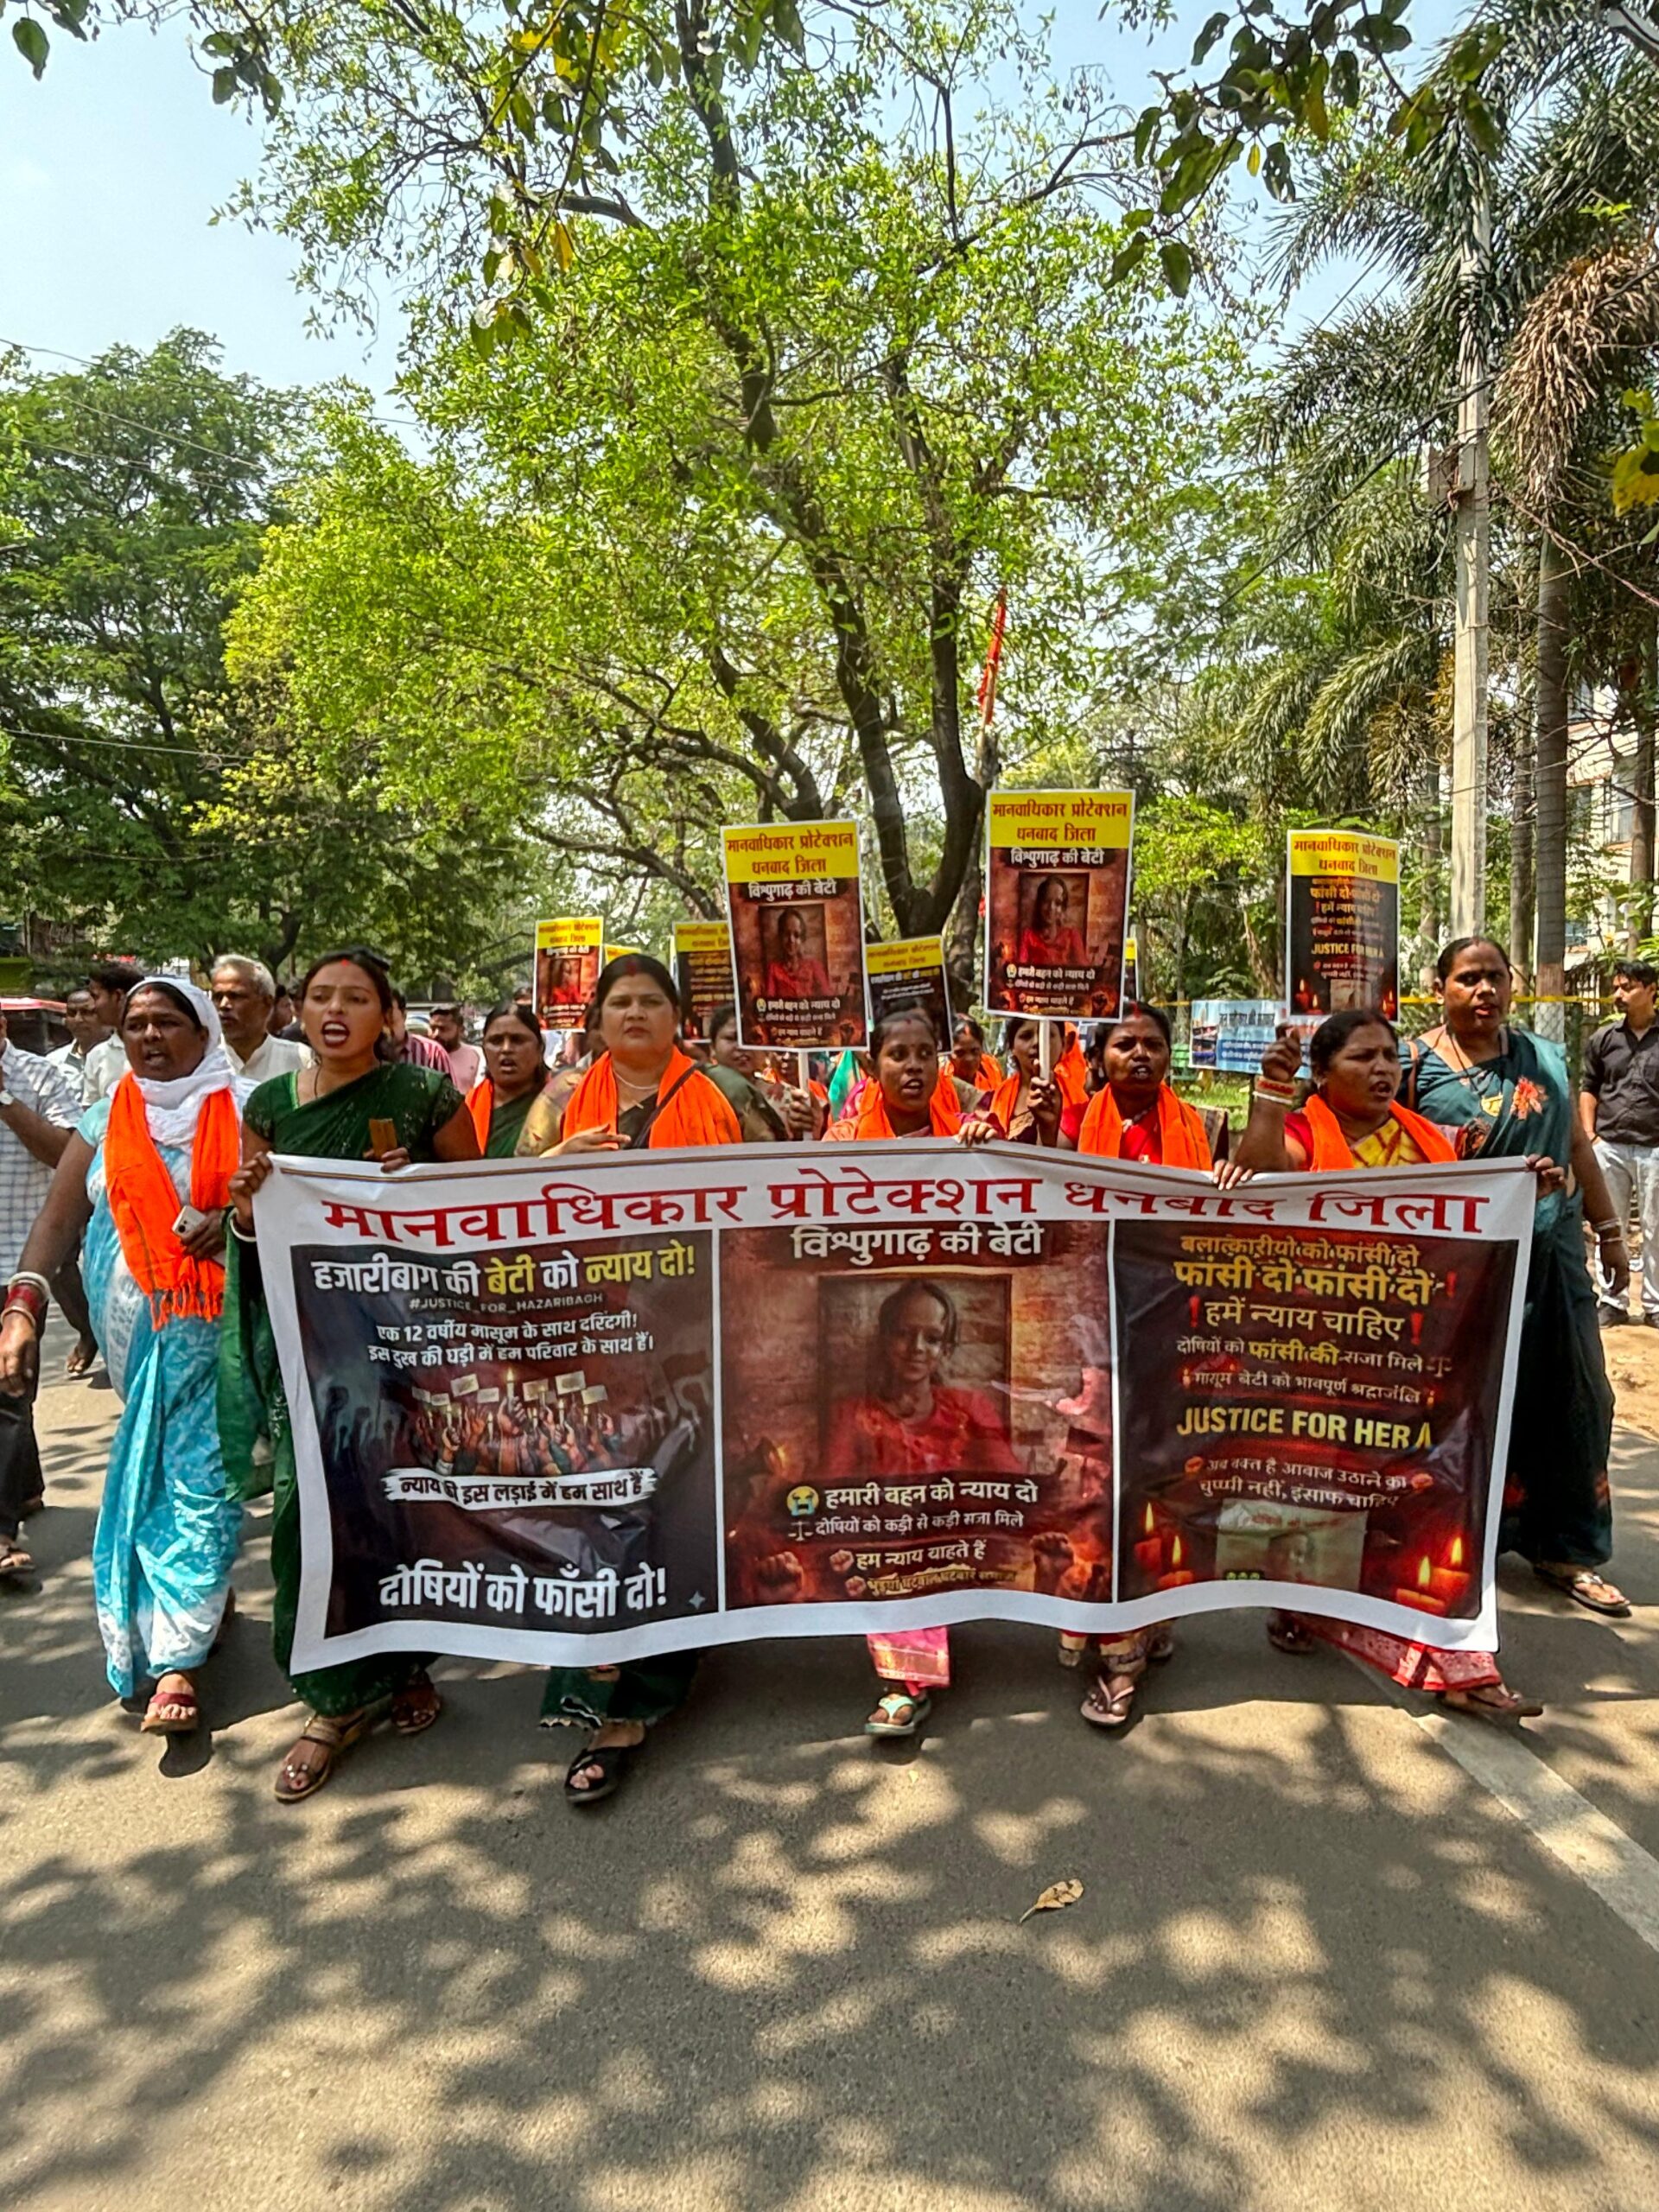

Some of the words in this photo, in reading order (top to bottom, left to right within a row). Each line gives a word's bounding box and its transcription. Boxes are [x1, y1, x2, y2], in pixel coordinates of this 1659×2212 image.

[993, 798, 1065, 817] मानवाधिकार
[1071, 798, 1128, 817] प्रोटेक्शन
[727, 833, 794, 852] मानवाधिकार
[799, 829, 853, 849] प्रोटेक्शन
[1064, 823, 1096, 841] जिला
[795, 855, 827, 874] जिला
[1062, 848, 1078, 864] की
[796, 880, 811, 896] की
[1311, 943, 1349, 955] JUSTICE
[321, 1183, 747, 1247] मानवाधिकार
[767, 1166, 1042, 1219] प्रोटेक्शन
[1064, 1182, 1287, 1221] धनबाद
[1307, 1191, 1491, 1234] जिला
[939, 1222, 982, 1255] की
[988, 1220, 1045, 1255] बेटी
[1300, 1237, 1330, 1261] को
[1337, 1241, 1392, 1266] फांसी
[1394, 1243, 1420, 1268] दो
[311, 1252, 438, 1293] हजारीबाग
[442, 1260, 480, 1297] की
[484, 1254, 536, 1296] बेटी
[540, 1249, 579, 1290] को
[583, 1250, 653, 1285] न्याय
[657, 1239, 695, 1276] दो!
[1174, 1255, 1255, 1289] फांसी
[1262, 1257, 1296, 1294] दो
[1302, 1262, 1390, 1300] फांसी
[1396, 1268, 1435, 1306] दो
[377, 1325, 400, 1341] एक
[404, 1325, 422, 1342] 12
[470, 1325, 518, 1344] मासूम
[522, 1321, 537, 1338] के
[542, 1320, 575, 1336] साथ
[1205, 1296, 1246, 1326] हमें
[1250, 1304, 1317, 1331] न्याय
[1322, 1306, 1405, 1340] चाहिए
[367, 1344, 390, 1362] इस
[421, 1345, 442, 1366] की
[446, 1342, 474, 1368] घड़ी
[478, 1343, 494, 1361] में
[498, 1346, 522, 1360] हम
[524, 1341, 577, 1360] परिवार
[582, 1336, 596, 1354] के
[601, 1337, 632, 1354] साथ
[1225, 1337, 1244, 1353] को
[1248, 1338, 1306, 1362] फांसी
[1310, 1343, 1340, 1366] की
[1387, 1351, 1423, 1372] मिले
[1238, 1369, 1268, 1387] बेटी
[1271, 1371, 1290, 1389] को
[1176, 1406, 1284, 1436] JUSTICE
[1292, 1410, 1347, 1441] FOR
[1354, 1420, 1411, 1450] HER
[1265, 1457, 1276, 1475] है
[1337, 1471, 1382, 1488] उठाने
[399, 1477, 441, 1494] न्याय
[461, 1484, 489, 1505] इस
[493, 1480, 537, 1507] लड़ाई
[539, 1481, 558, 1501] में
[562, 1484, 588, 1500] हम
[591, 1481, 628, 1500] साथ
[629, 1471, 645, 1495] हैं
[824, 1481, 881, 1509] हमारी
[930, 1478, 955, 1503] को
[959, 1481, 1011, 1501] न्याय
[1014, 1478, 1038, 1503] दो
[1291, 1483, 1344, 1503] इंसाफ
[863, 1514, 881, 1534] को
[885, 1514, 914, 1535] कड़ी
[917, 1514, 929, 1529] से
[932, 1510, 959, 1530] कड़ी
[995, 1510, 1024, 1528] मिले
[855, 1553, 880, 1569] हम
[885, 1548, 923, 1566] न्याय
[973, 1538, 988, 1560] हैं
[378, 1558, 484, 1609] दोषियों
[485, 1563, 529, 1614] को
[533, 1563, 620, 1619] फाँसी
[624, 1561, 666, 1611] दो!
